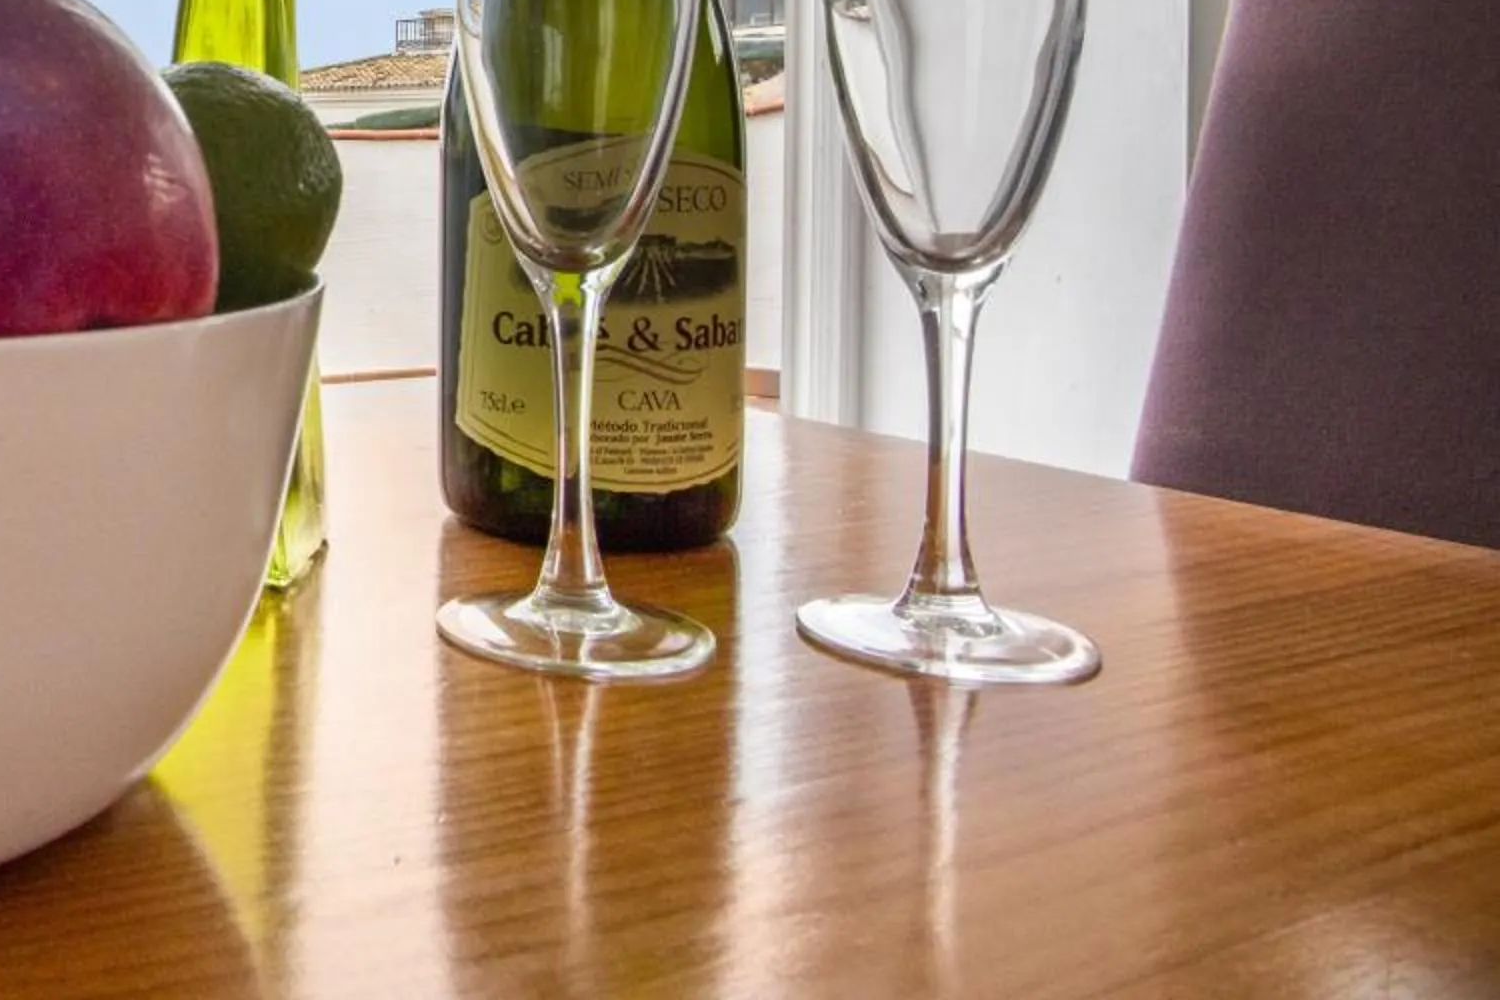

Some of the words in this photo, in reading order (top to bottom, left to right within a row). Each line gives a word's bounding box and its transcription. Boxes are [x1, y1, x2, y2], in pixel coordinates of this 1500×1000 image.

[657, 184, 728, 214] SECO
[627, 316, 662, 352] &
[617, 390, 682, 412] CAVA
[641, 416, 709, 433] Tradicional
